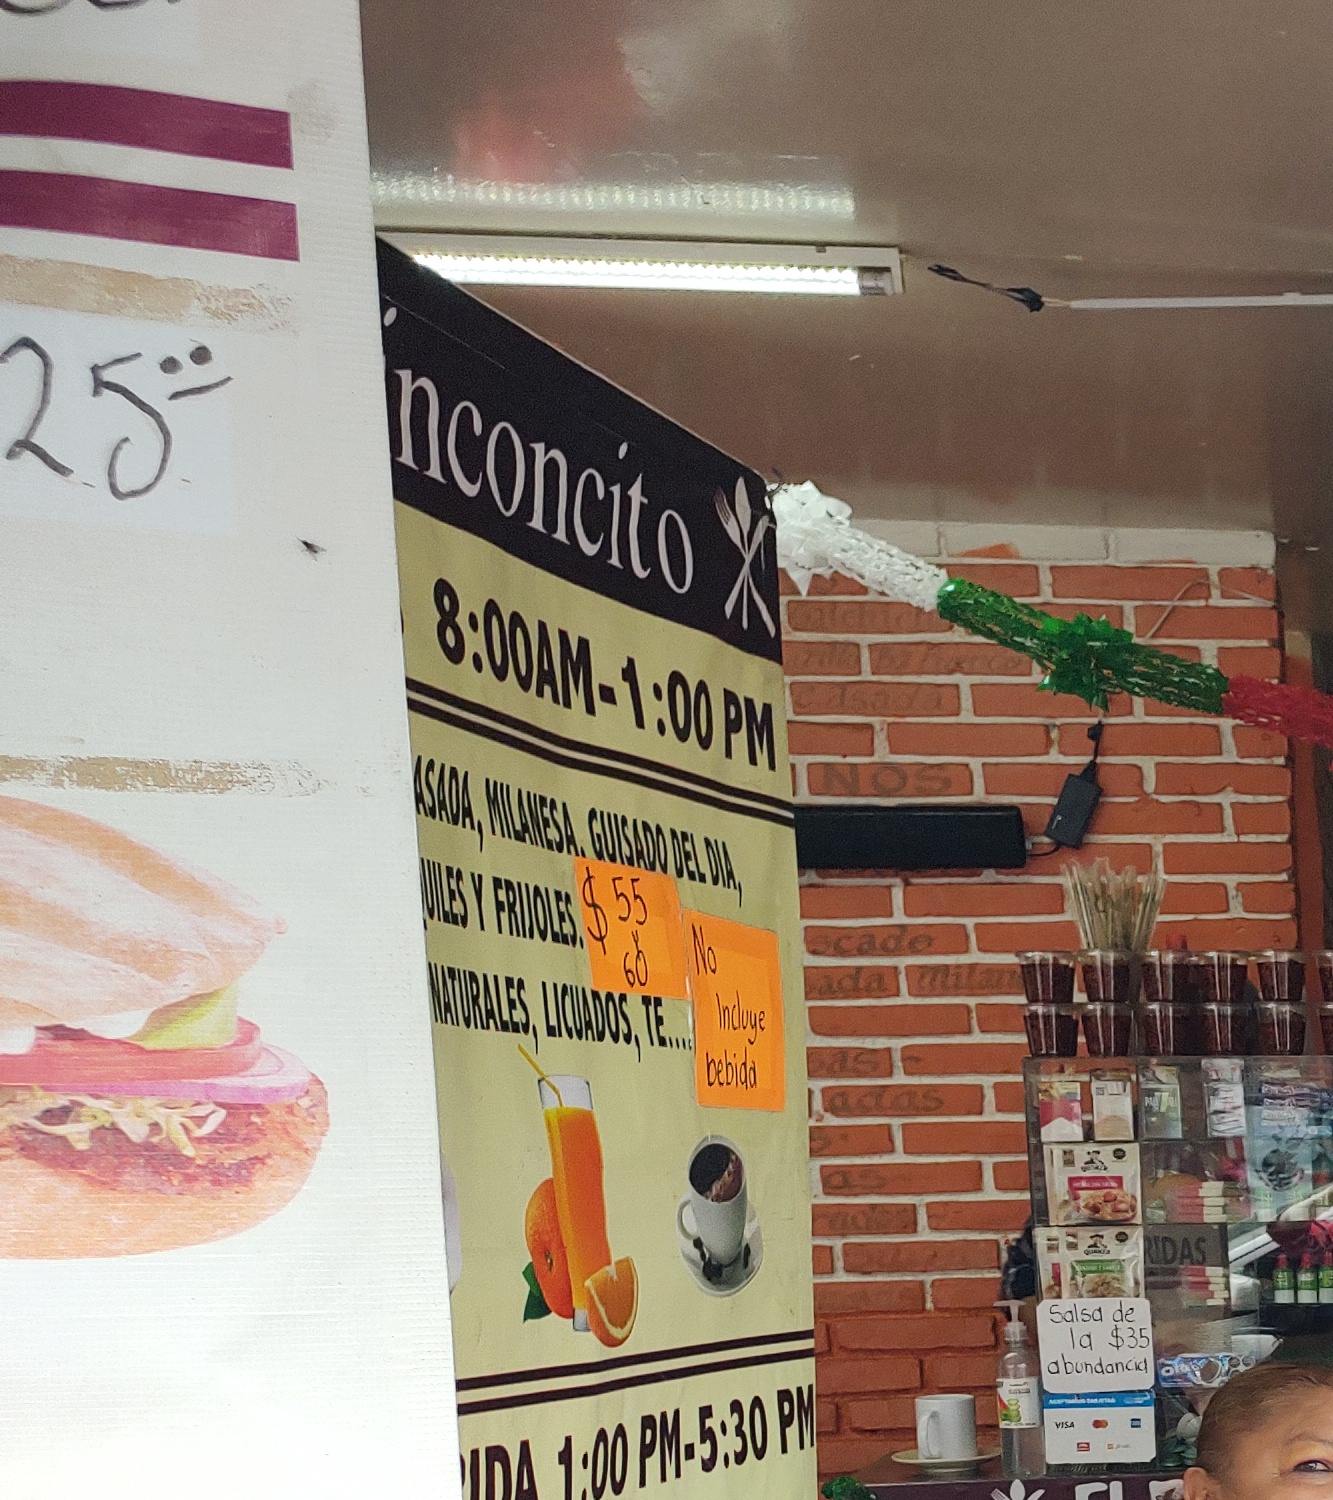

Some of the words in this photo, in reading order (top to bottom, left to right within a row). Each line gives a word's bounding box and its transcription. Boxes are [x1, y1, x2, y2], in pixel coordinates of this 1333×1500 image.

[383, 306, 695, 597] nconcito
[724, 688, 776, 772] PM
[588, 807, 668, 874] GUISADO
[670, 827, 706, 884] DEL
[471, 875, 485, 931] Y
[691, 922, 718, 975] No
[716, 992, 767, 1045] Incluye
[705, 1050, 758, 1089] bebida
[1050, 1303, 1103, 1324] Salsa
[1112, 1300, 1135, 1323] de
[1070, 1327, 1093, 1351] la
[1108, 1325, 1150, 1350] $35
[1047, 1353, 1149, 1375] abundancia
[777, 1383, 815, 1456] PM
[1054, 1421, 1076, 1429] VISA
